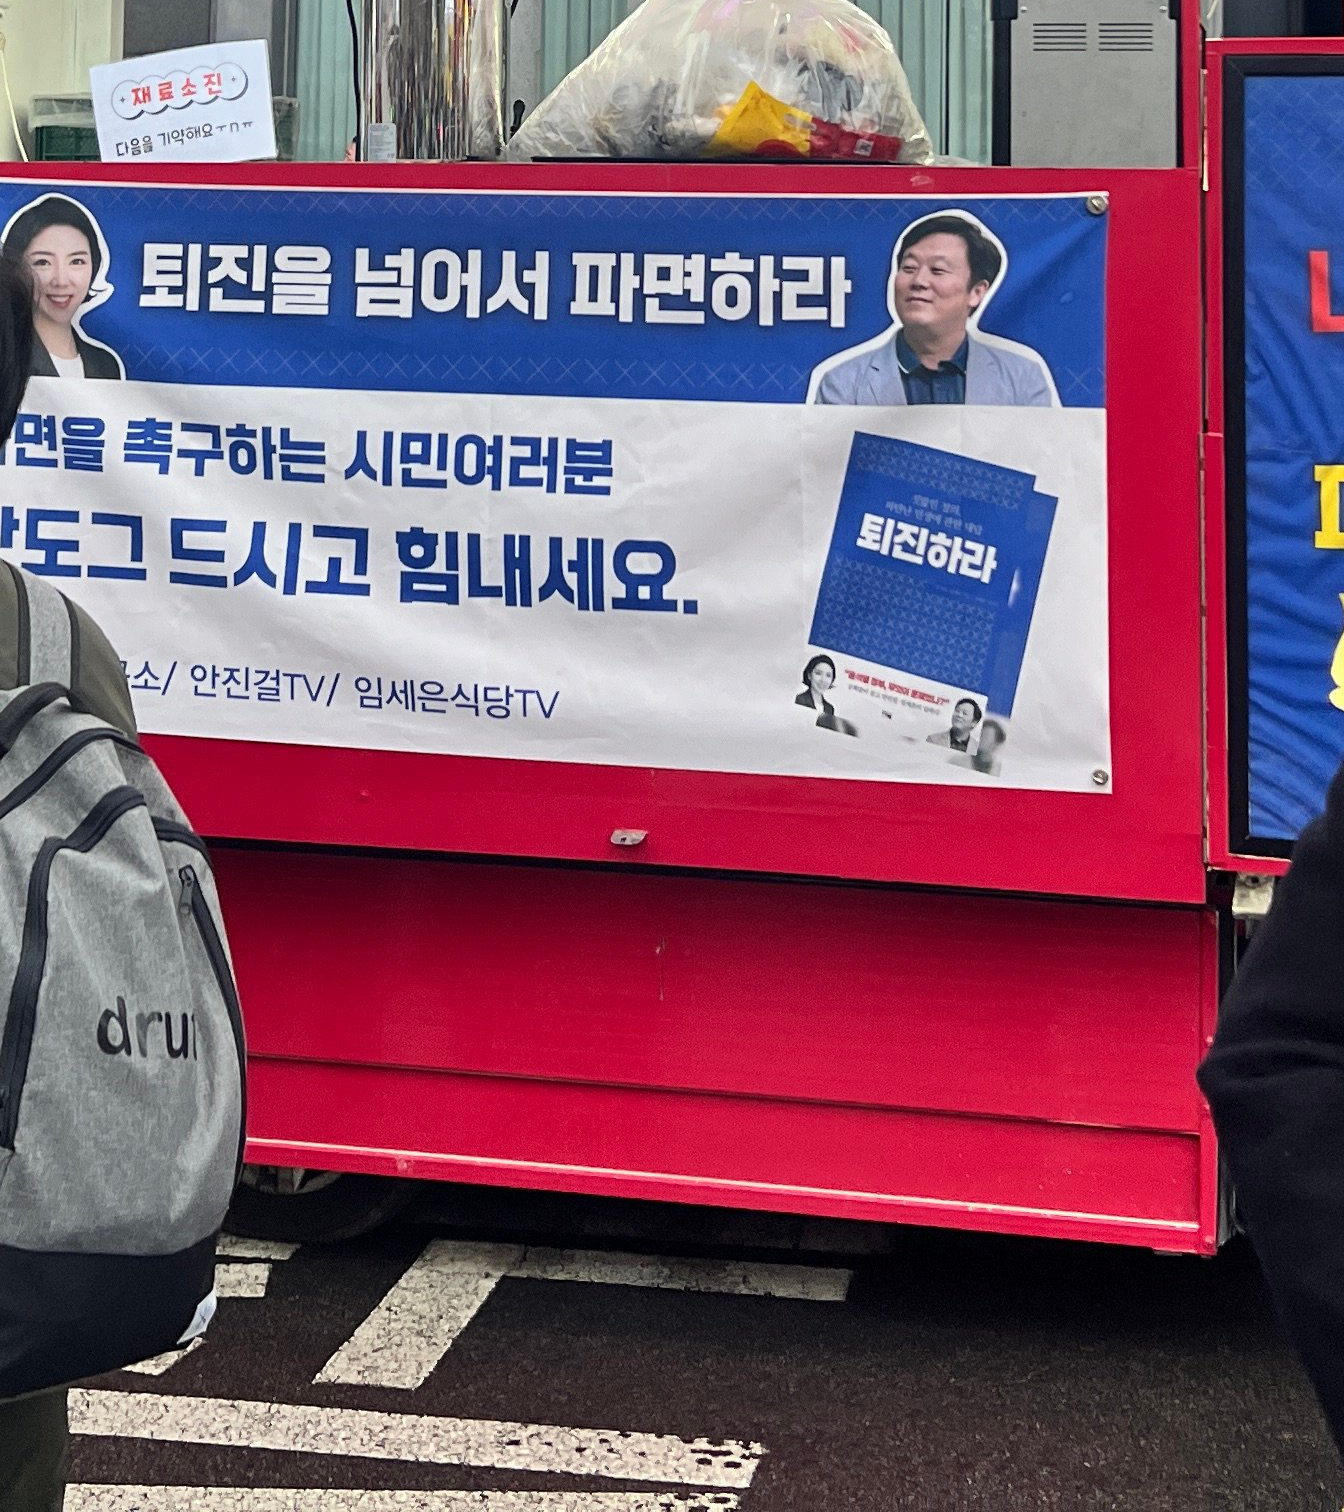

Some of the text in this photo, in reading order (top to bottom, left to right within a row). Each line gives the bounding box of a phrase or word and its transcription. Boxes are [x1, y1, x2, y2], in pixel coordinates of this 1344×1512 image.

[130, 72, 223, 107] 재료소진
[115, 135, 154, 157] 다음을
[139, 242, 852, 329] 퇴진을 넘어서 파면하라
[123, 417, 327, 484] 촉구하는
[344, 433, 615, 496] 시민여러분
[168, 518, 373, 597] 드시고
[397, 528, 700, 617] 힘내세요.
[855, 512, 998, 585] 퇴진하라
[119, 659, 560, 720] 소/ 안진걸TV/ 임세은식당TV
